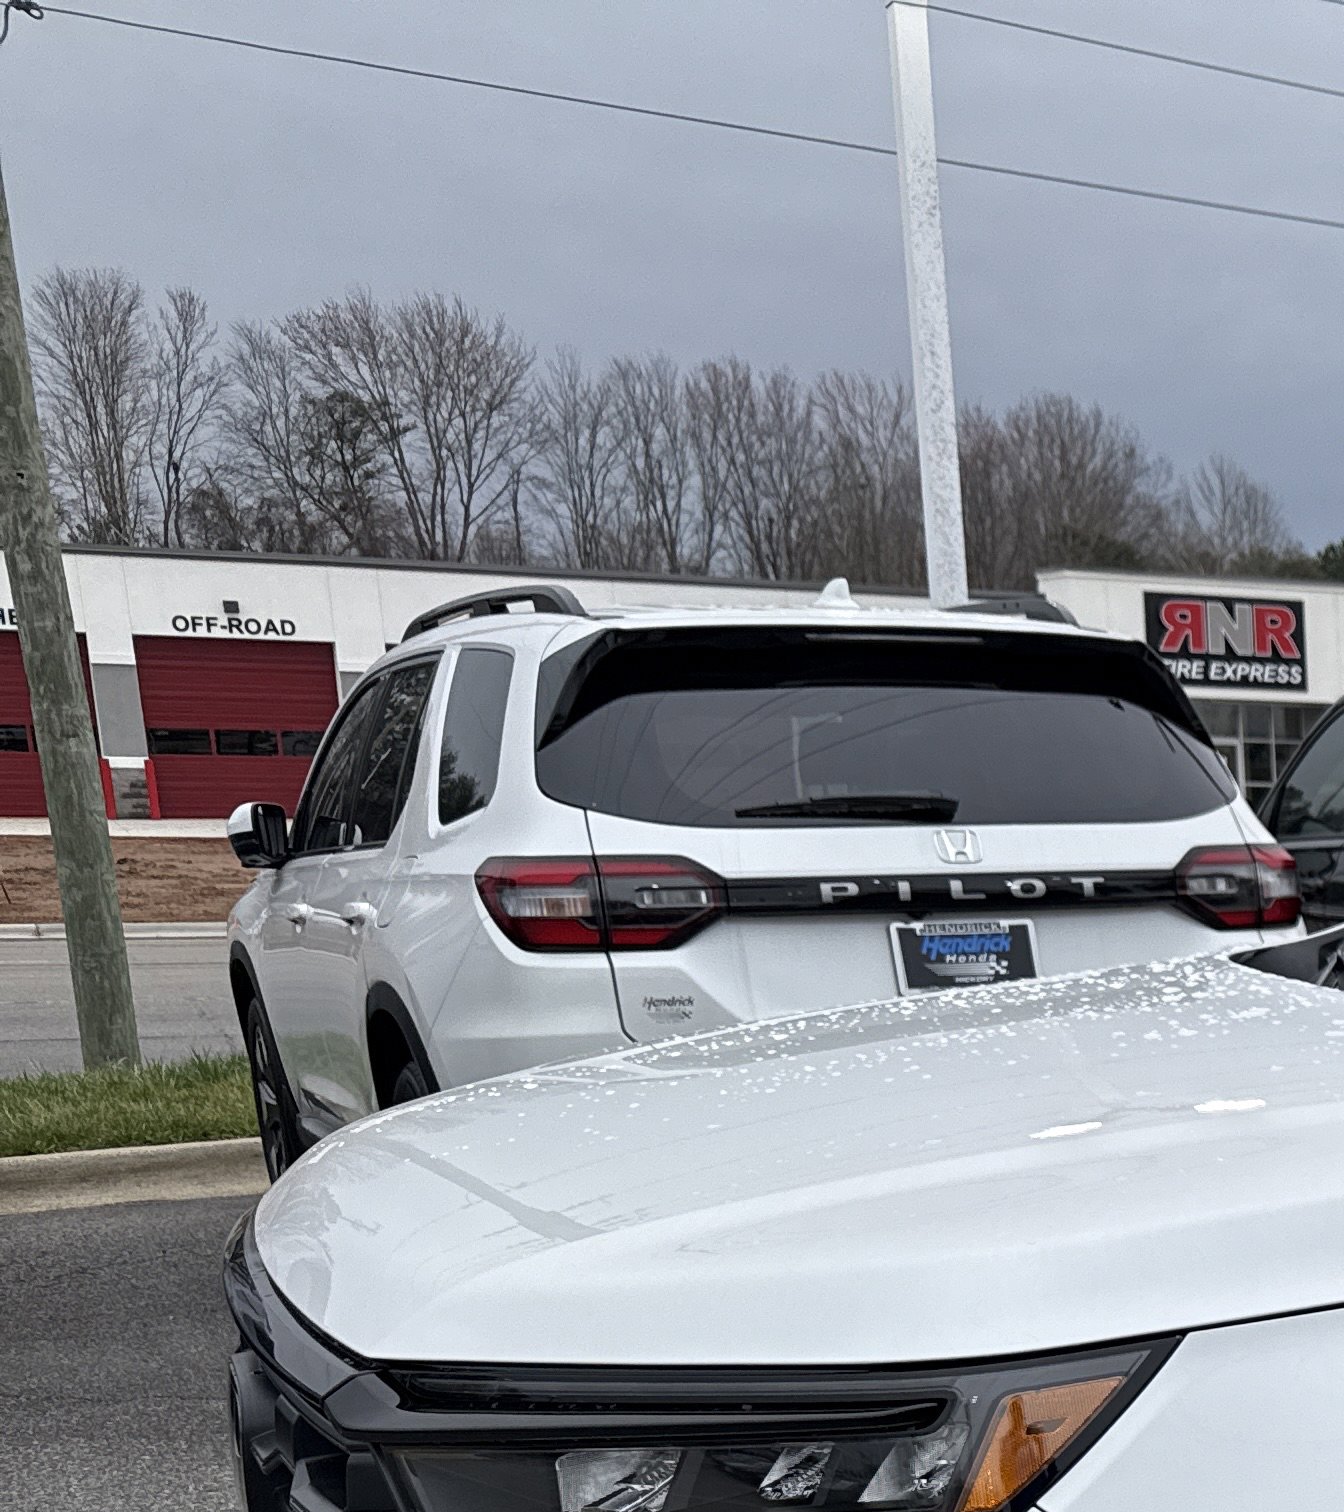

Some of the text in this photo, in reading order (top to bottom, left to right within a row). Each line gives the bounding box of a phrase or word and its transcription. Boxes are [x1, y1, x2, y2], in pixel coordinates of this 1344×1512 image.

[171, 614, 297, 637] OFF-ROAD
[1159, 600, 1302, 659] RNR
[1209, 660, 1303, 685] EXPRESS
[819, 875, 1105, 904] PILOT
[924, 922, 1001, 935] HENDRICK
[921, 933, 1012, 960] Hendrick
[945, 952, 998, 964] Honda
[641, 995, 695, 1011] Hendrick
